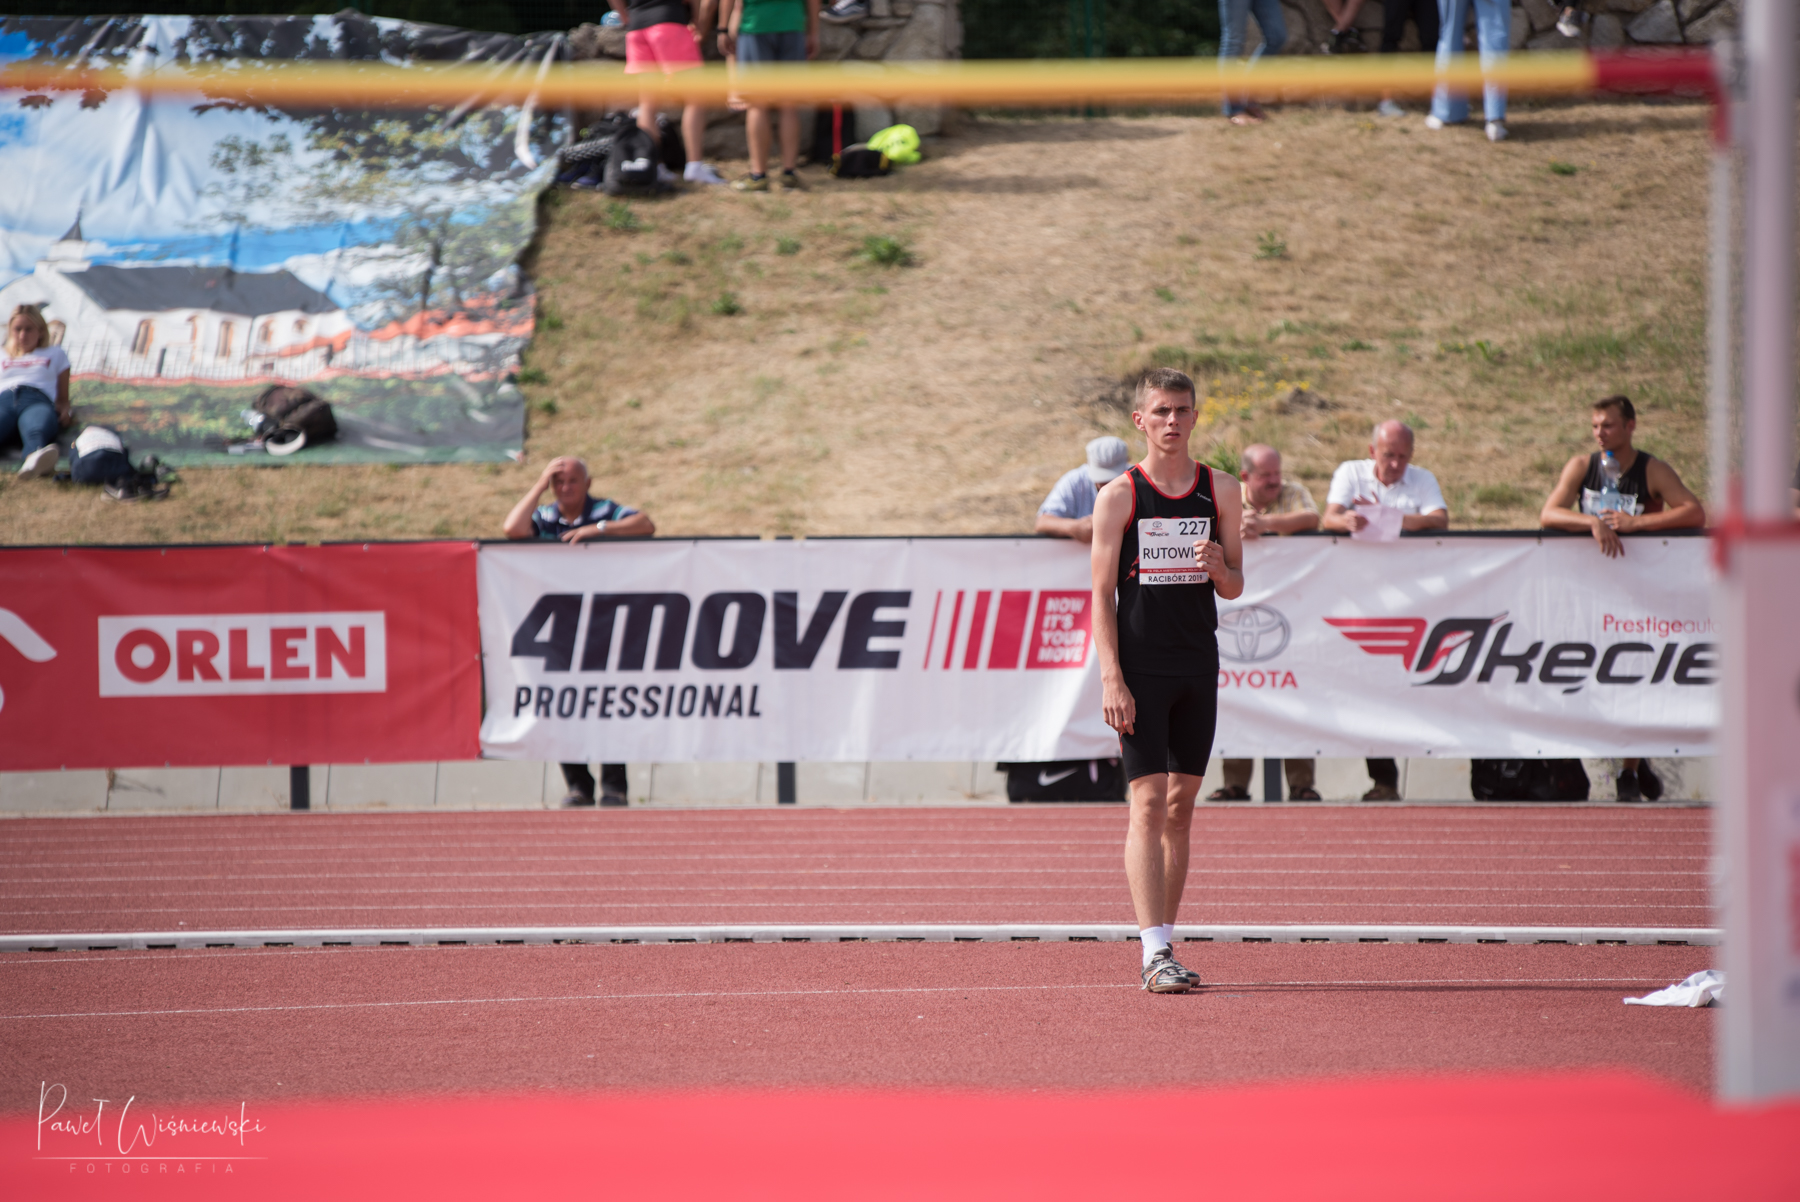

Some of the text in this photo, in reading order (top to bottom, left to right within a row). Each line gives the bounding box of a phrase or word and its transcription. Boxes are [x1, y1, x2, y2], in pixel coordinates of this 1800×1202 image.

[1178, 520, 1207, 536] 227
[1143, 546, 1197, 560] RUTOWI
[1148, 573, 1203, 583] RACIBÓRZ 2019
[1045, 597, 1085, 613] NOW
[1042, 613, 1074, 630] IT'S
[511, 590, 912, 671] 4MOVE
[1041, 629, 1086, 646] YOUR
[114, 625, 366, 685] ORLEN
[1037, 646, 1084, 662] MOVE
[1218, 669, 1298, 688] OYOTA
[513, 684, 762, 719] PROFESSIONAL
